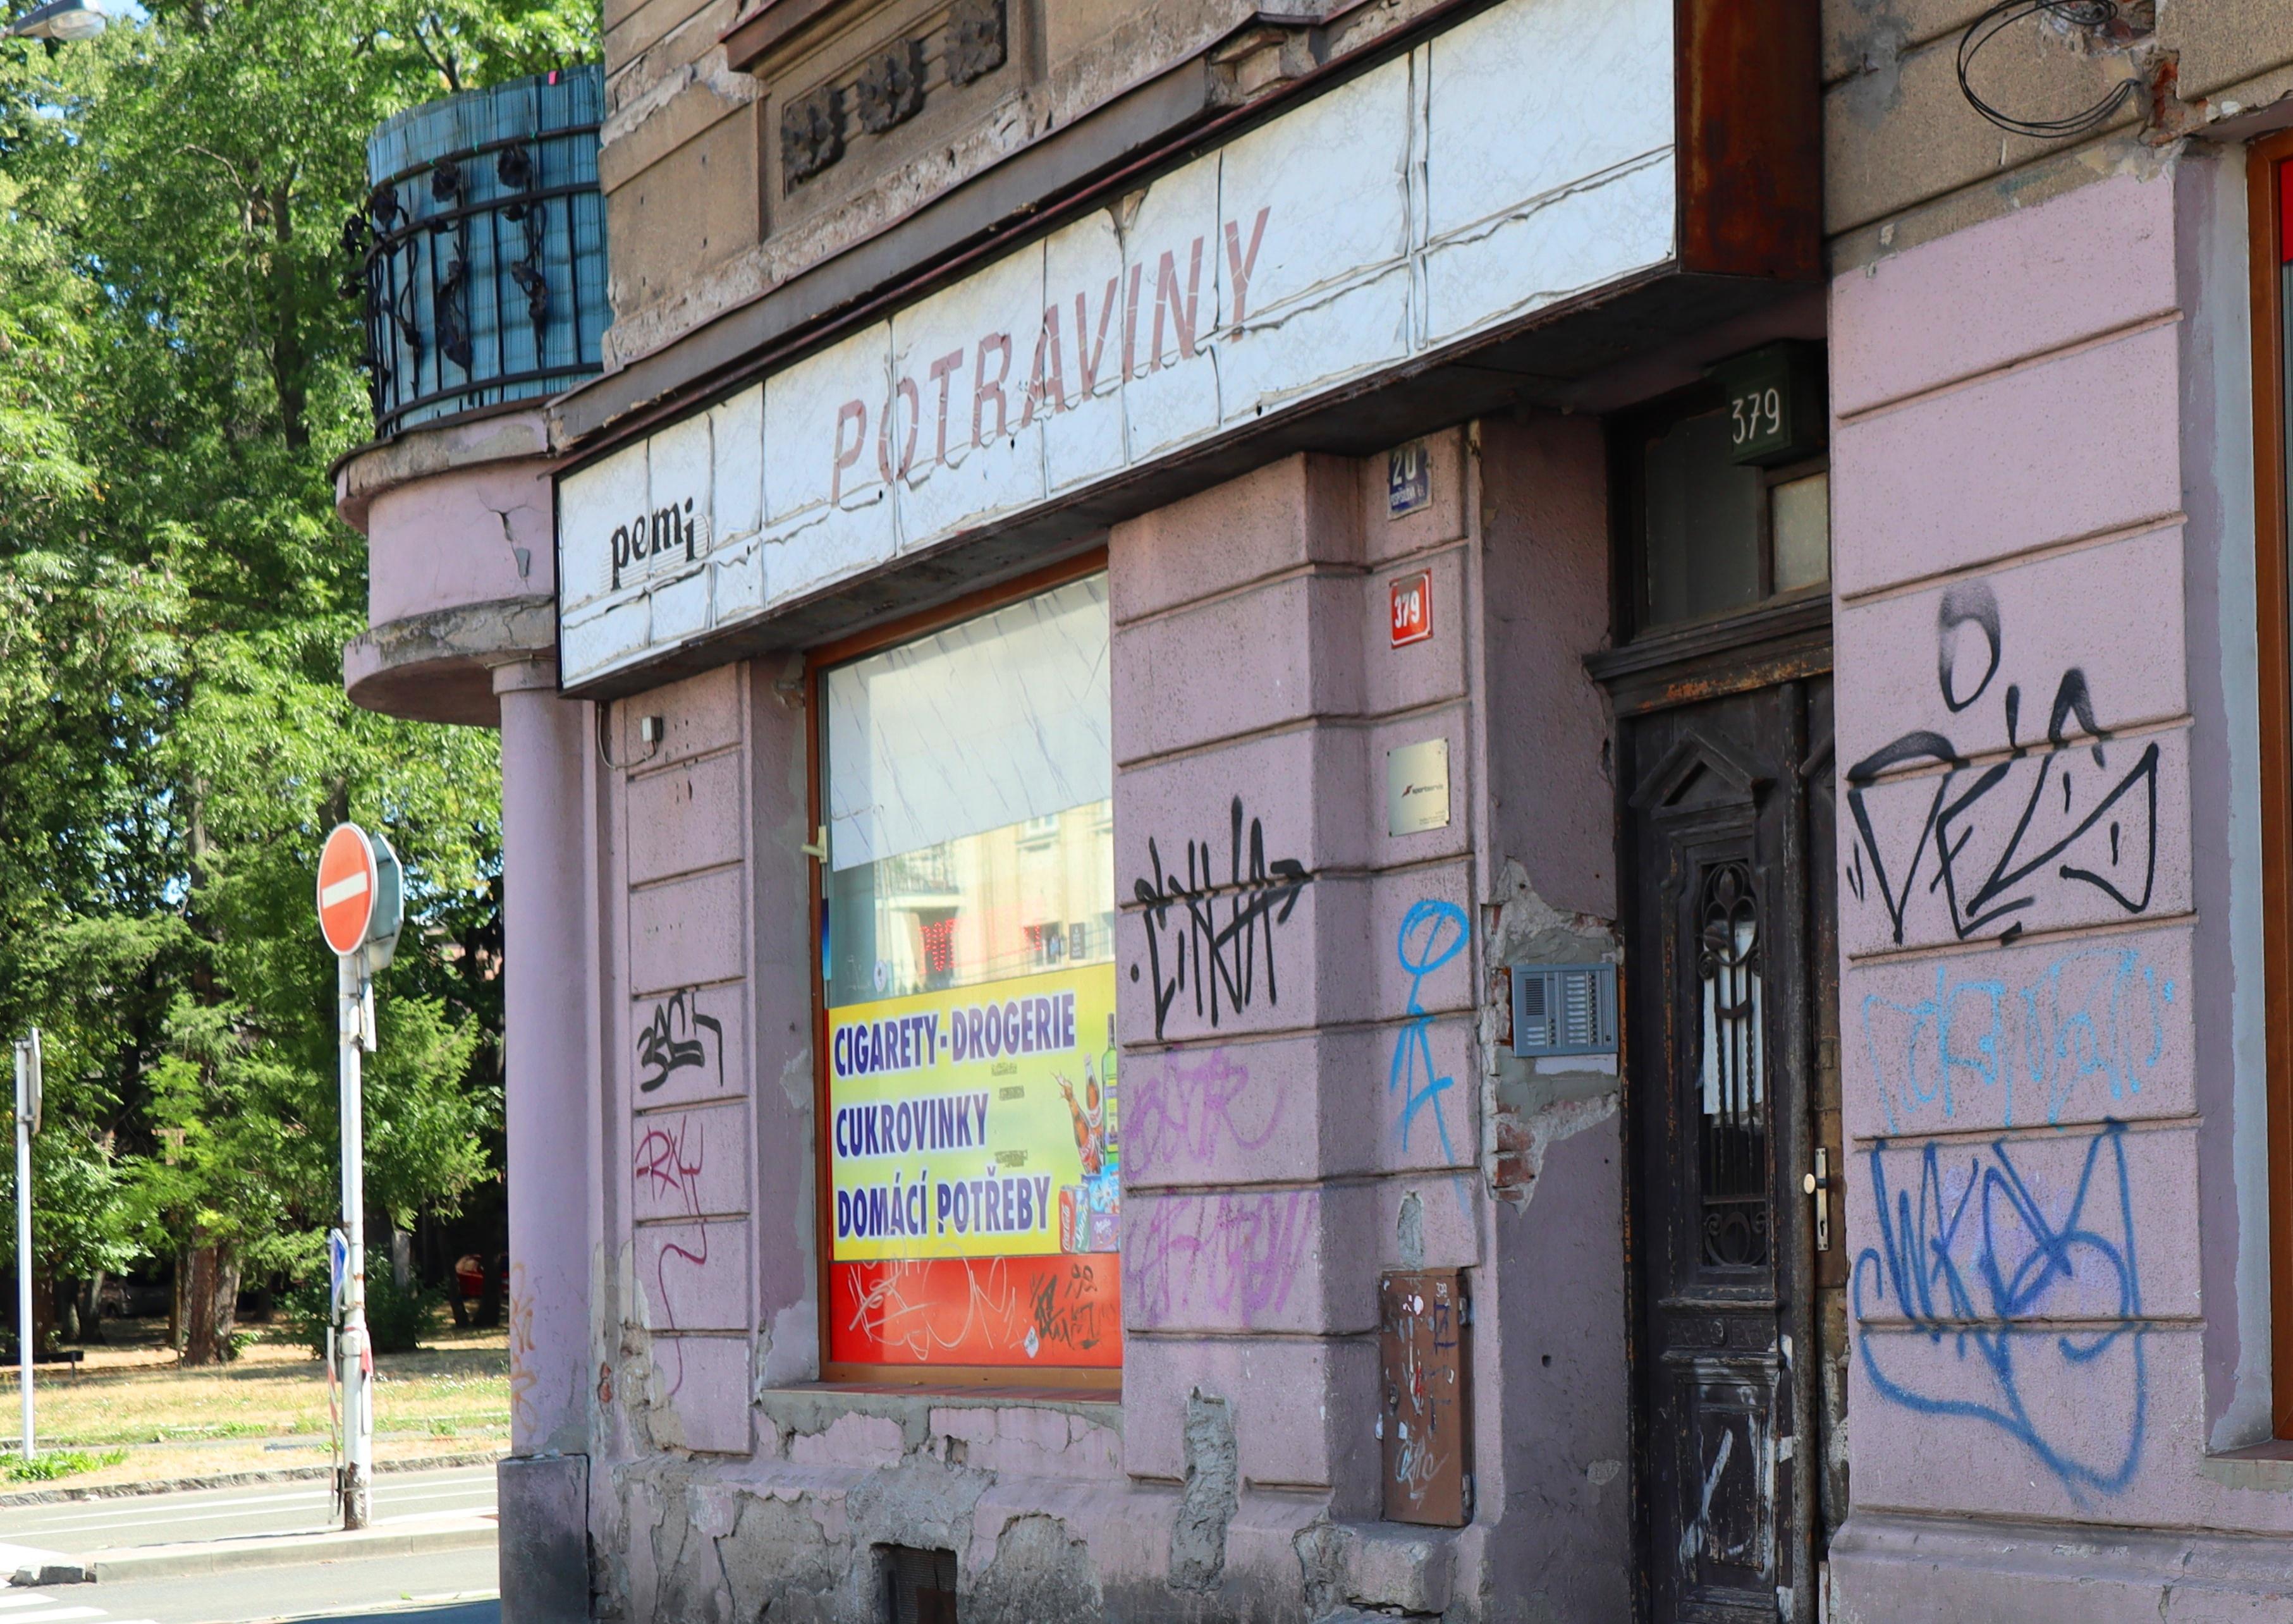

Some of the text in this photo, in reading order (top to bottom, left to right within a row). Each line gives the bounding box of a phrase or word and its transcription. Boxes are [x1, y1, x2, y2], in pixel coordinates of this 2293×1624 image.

[831, 207, 1271, 507] POTRAVINY
[1732, 388, 1780, 444] 379
[1393, 446, 1417, 486] 20
[1395, 590, 1420, 628] 379
[835, 1093, 989, 1158] CUKROVINKY
[837, 1166, 1051, 1238] DOMÁCÍ POTŘEBY
